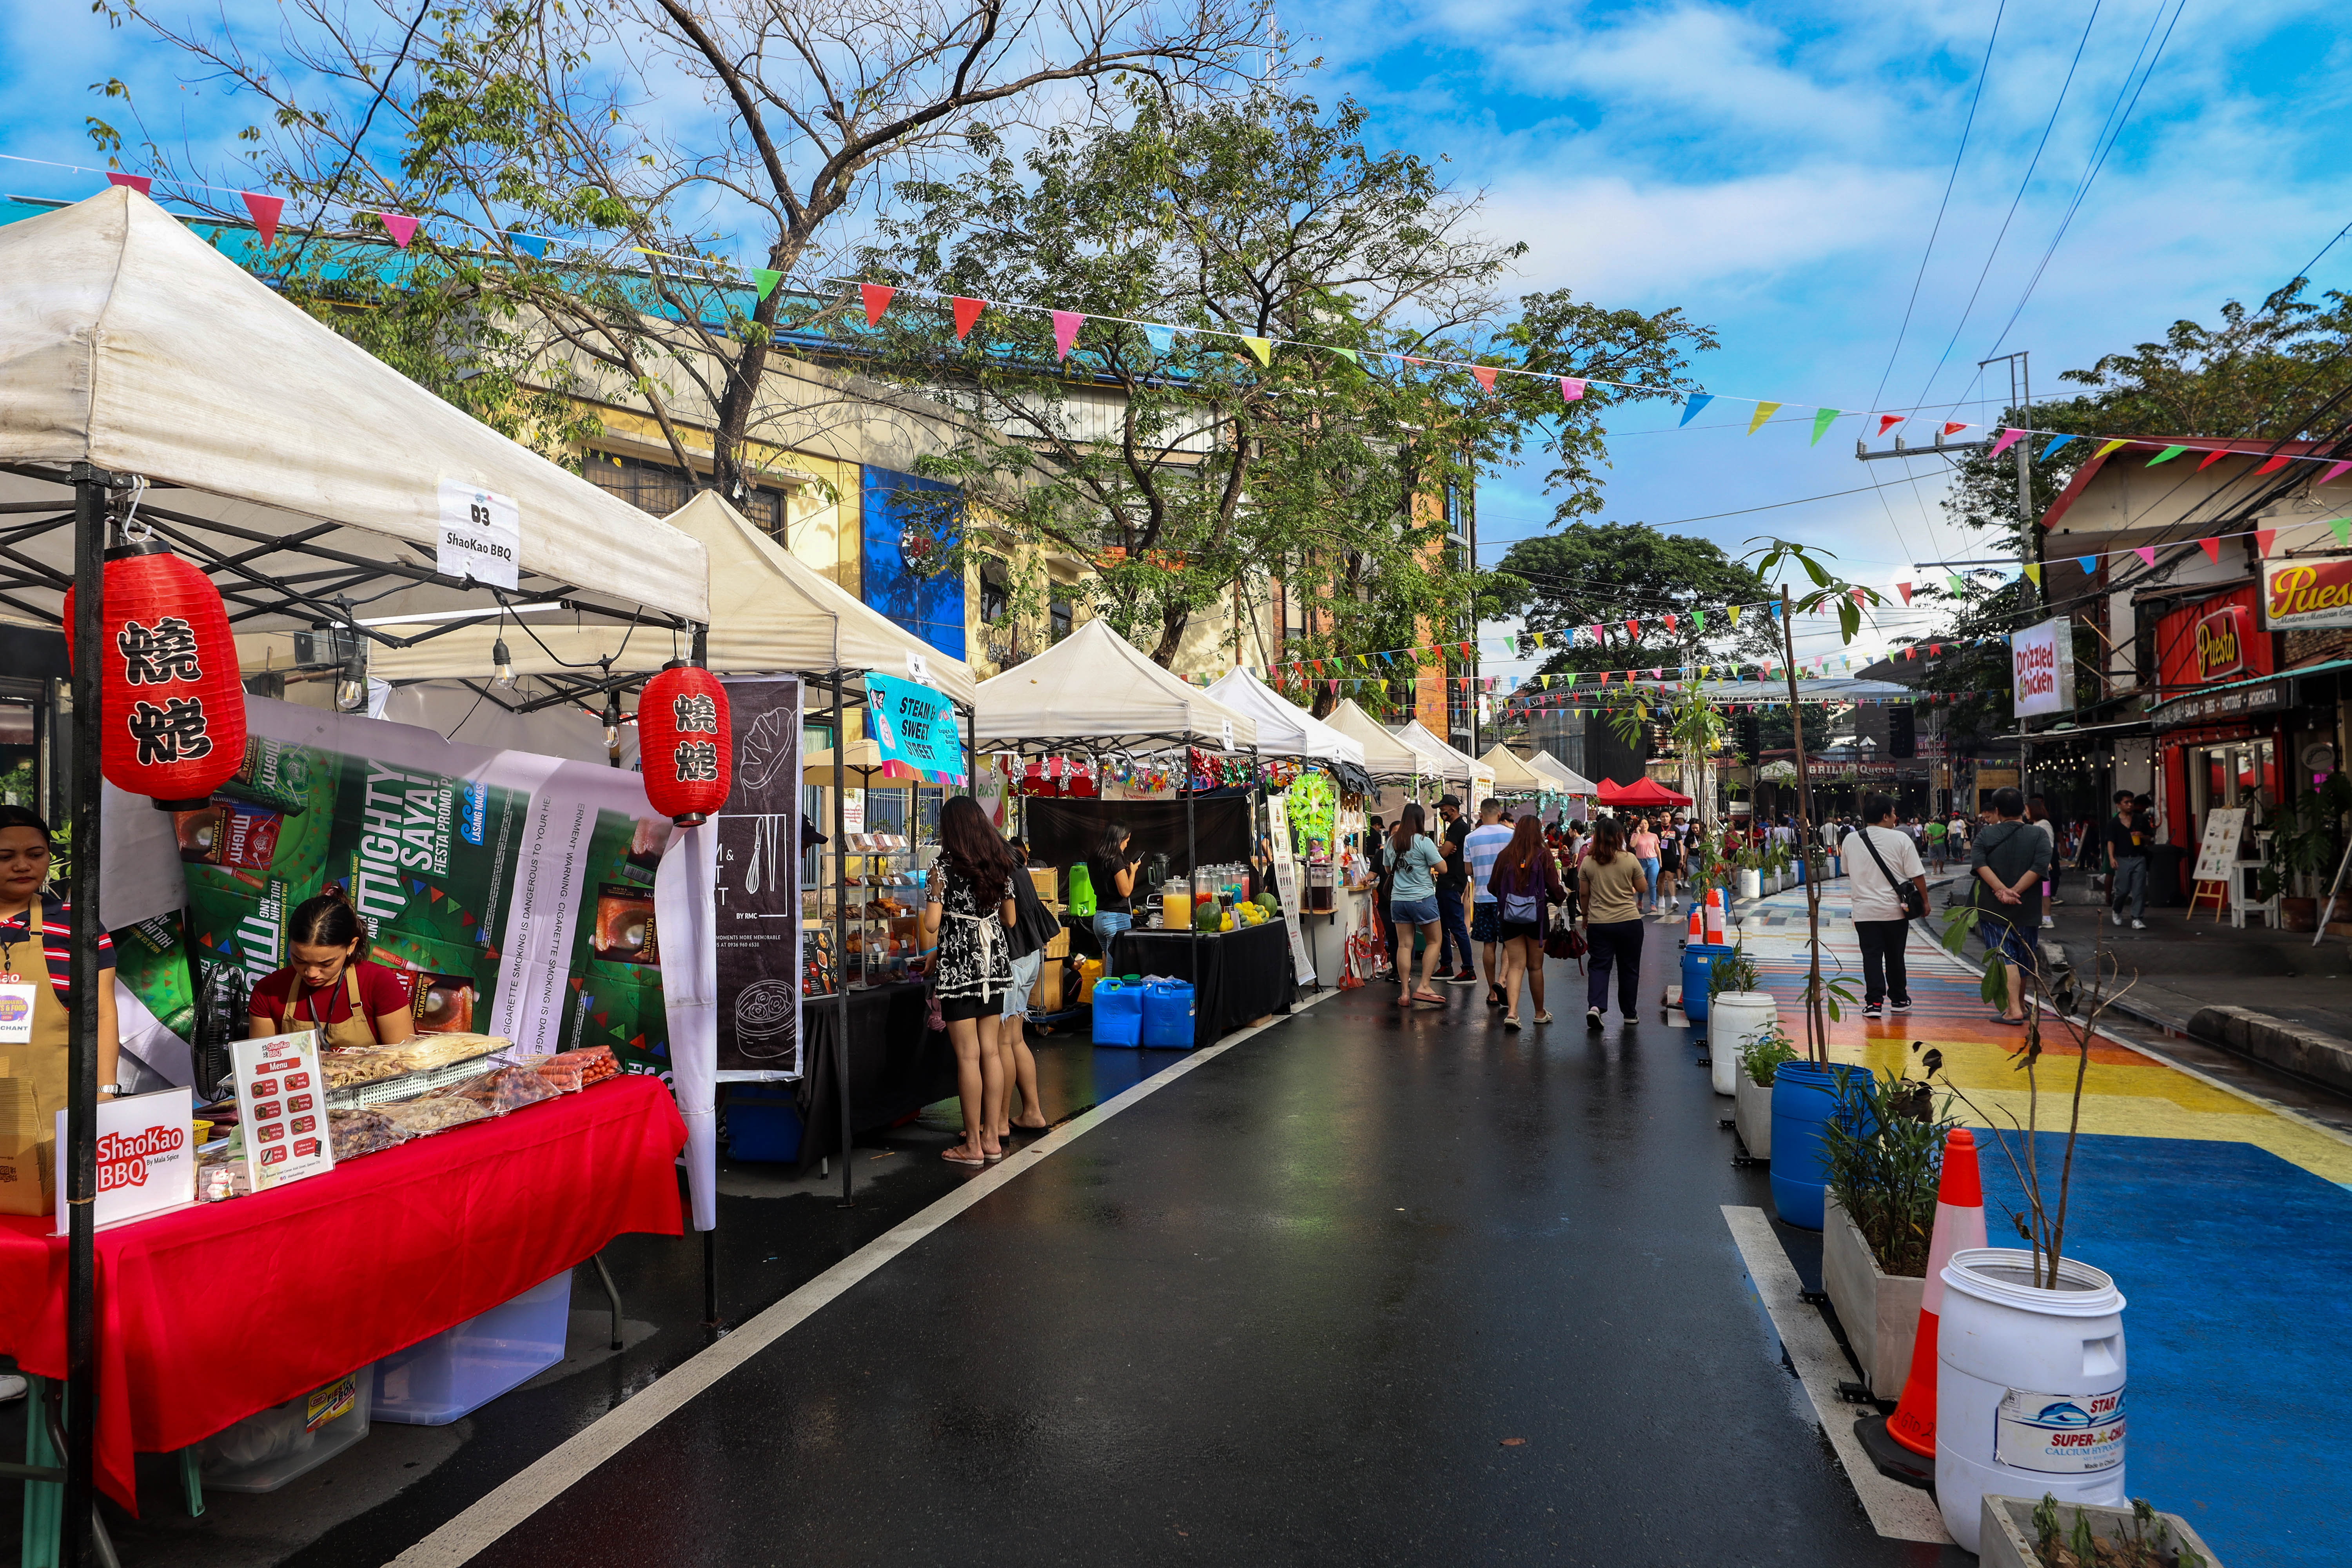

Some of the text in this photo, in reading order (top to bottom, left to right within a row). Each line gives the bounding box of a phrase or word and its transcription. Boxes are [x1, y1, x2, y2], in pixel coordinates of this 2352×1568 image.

[471, 504, 490, 526] D3
[446, 532, 511, 562] ShaoKao BBQ
[2268, 566, 2352, 619] Pues
[2277, 611, 2338, 625] Modern Mexican
[2016, 642, 2053, 676] Drizzled
[2198, 617, 2235, 677] Puesto
[900, 697, 929, 719] STEAM
[931, 704, 936, 721] &
[2185, 702, 2199, 717] SALAD
[2205, 700, 2215, 713] RIBS
[2222, 694, 2241, 711] HOTDOG
[2249, 688, 2276, 706] HORCHATA
[901, 719, 930, 740] SWEET
[242, 738, 253, 771] KATARATA
[261, 738, 280, 790] MIGHTY
[904, 739, 936, 760] STREET
[1809, 765, 1894, 775] GRILL Queen
[977, 783, 999, 798] BLAST
[400, 775, 437, 871] SAYA!
[437, 789, 452, 833] PROMO
[472, 779, 486, 842] LASANG NAKASA
[211, 821, 220, 854] KATARATA
[229, 814, 251, 864] MIGHTY
[357, 759, 406, 920] MIGHTY
[535, 814, 546, 842] YOUR
[568, 802, 585, 850] ERNMENT
[434, 835, 449, 875] FIESTA
[533, 842, 541, 858] TO
[523, 859, 538, 920] DANGEROUS
[560, 851, 572, 900] WARNING:
[259, 897, 269, 918] ANG
[269, 880, 280, 921] HULIHIN
[140, 919, 174, 948] HULIHI
[367, 916, 379, 939] ANG
[520, 920, 528, 930] IS
[551, 902, 566, 958] CIGARETTE
[643, 918, 654, 953] KATARATA
[147, 941, 162, 953] MULA
[512, 930, 527, 978] SMOKING
[543, 960, 555, 1004] SMOKING
[417, 984, 428, 1018] KATARATA
[503, 980, 518, 1034] CIGARETTE
[541, 1007, 549, 1016] IS
[267, 1042, 290, 1051] ShaoKao
[269, 1049, 281, 1057] BBQ
[269, 1062, 288, 1071] Menu
[97, 1129, 184, 1162] ShaoKao
[100, 1156, 147, 1189] BBQ
[166, 1153, 180, 1162] Spice
[327, 1380, 350, 1403] FIESTA
[338, 1381, 354, 1402] BOX
[2090, 1396, 2116, 1414] STAR
[2045, 1447, 2091, 1456] CALCIUM
[2104, 1458, 2116, 1466] China
